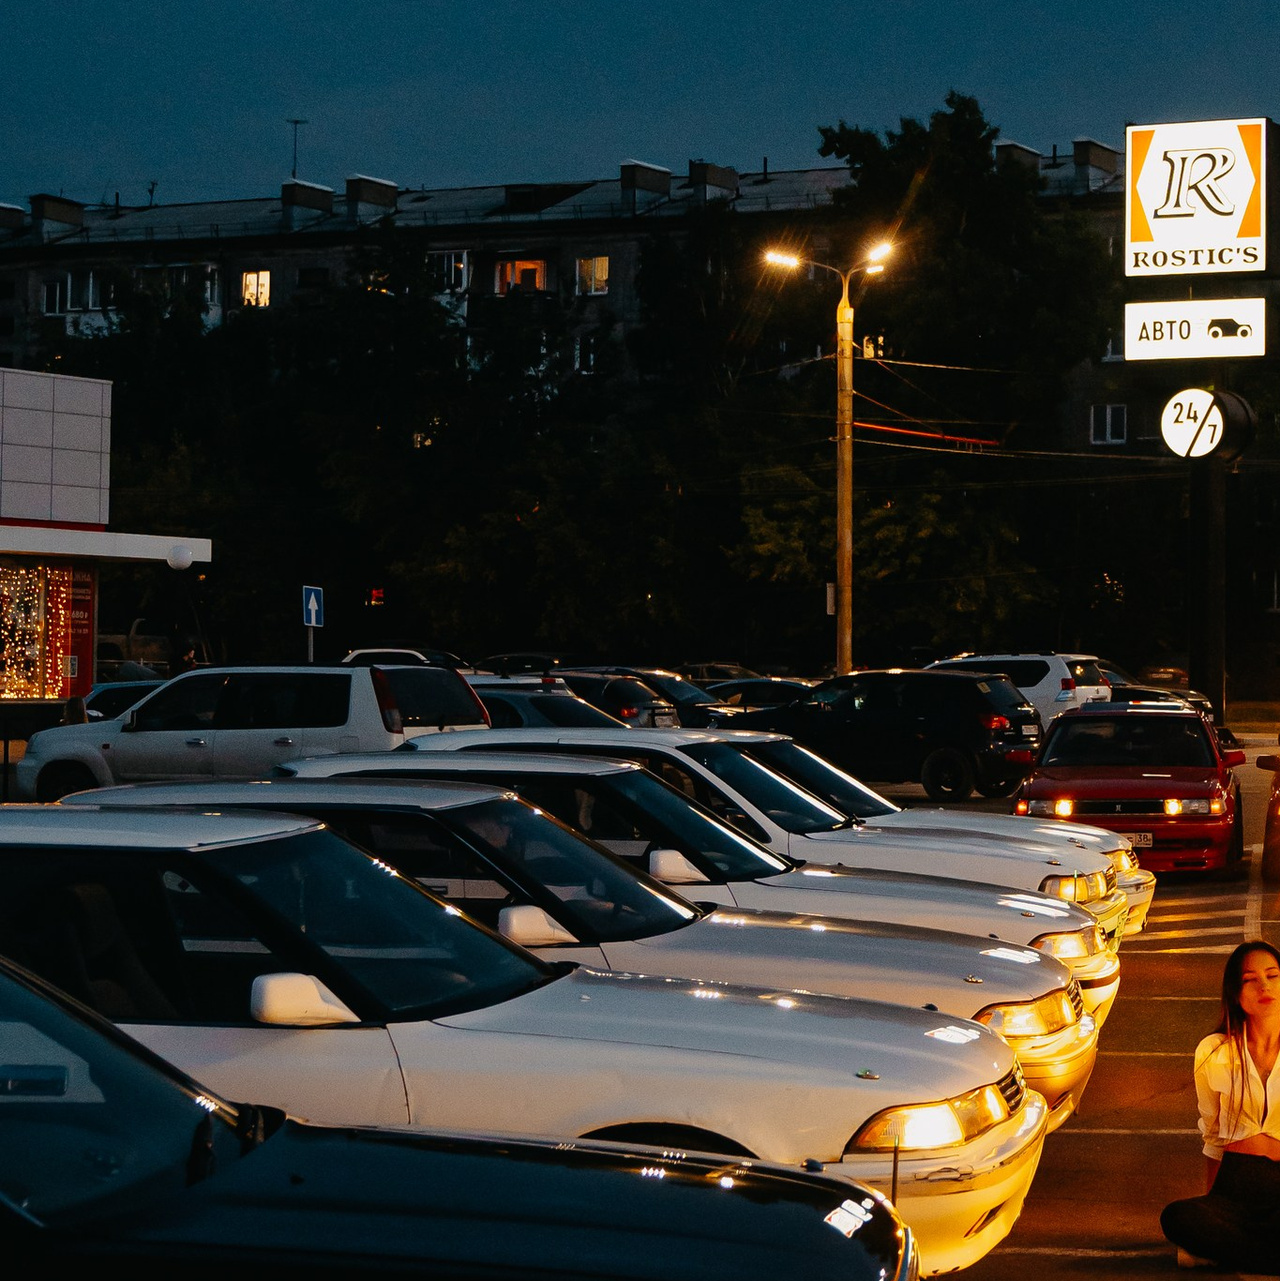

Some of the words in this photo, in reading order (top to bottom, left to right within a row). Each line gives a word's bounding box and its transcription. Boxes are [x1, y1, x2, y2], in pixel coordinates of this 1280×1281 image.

[1153, 147, 1236, 219] R
[1132, 246, 1259, 268] ROSTIC'S
[1138, 320, 1191, 341] АВТО
